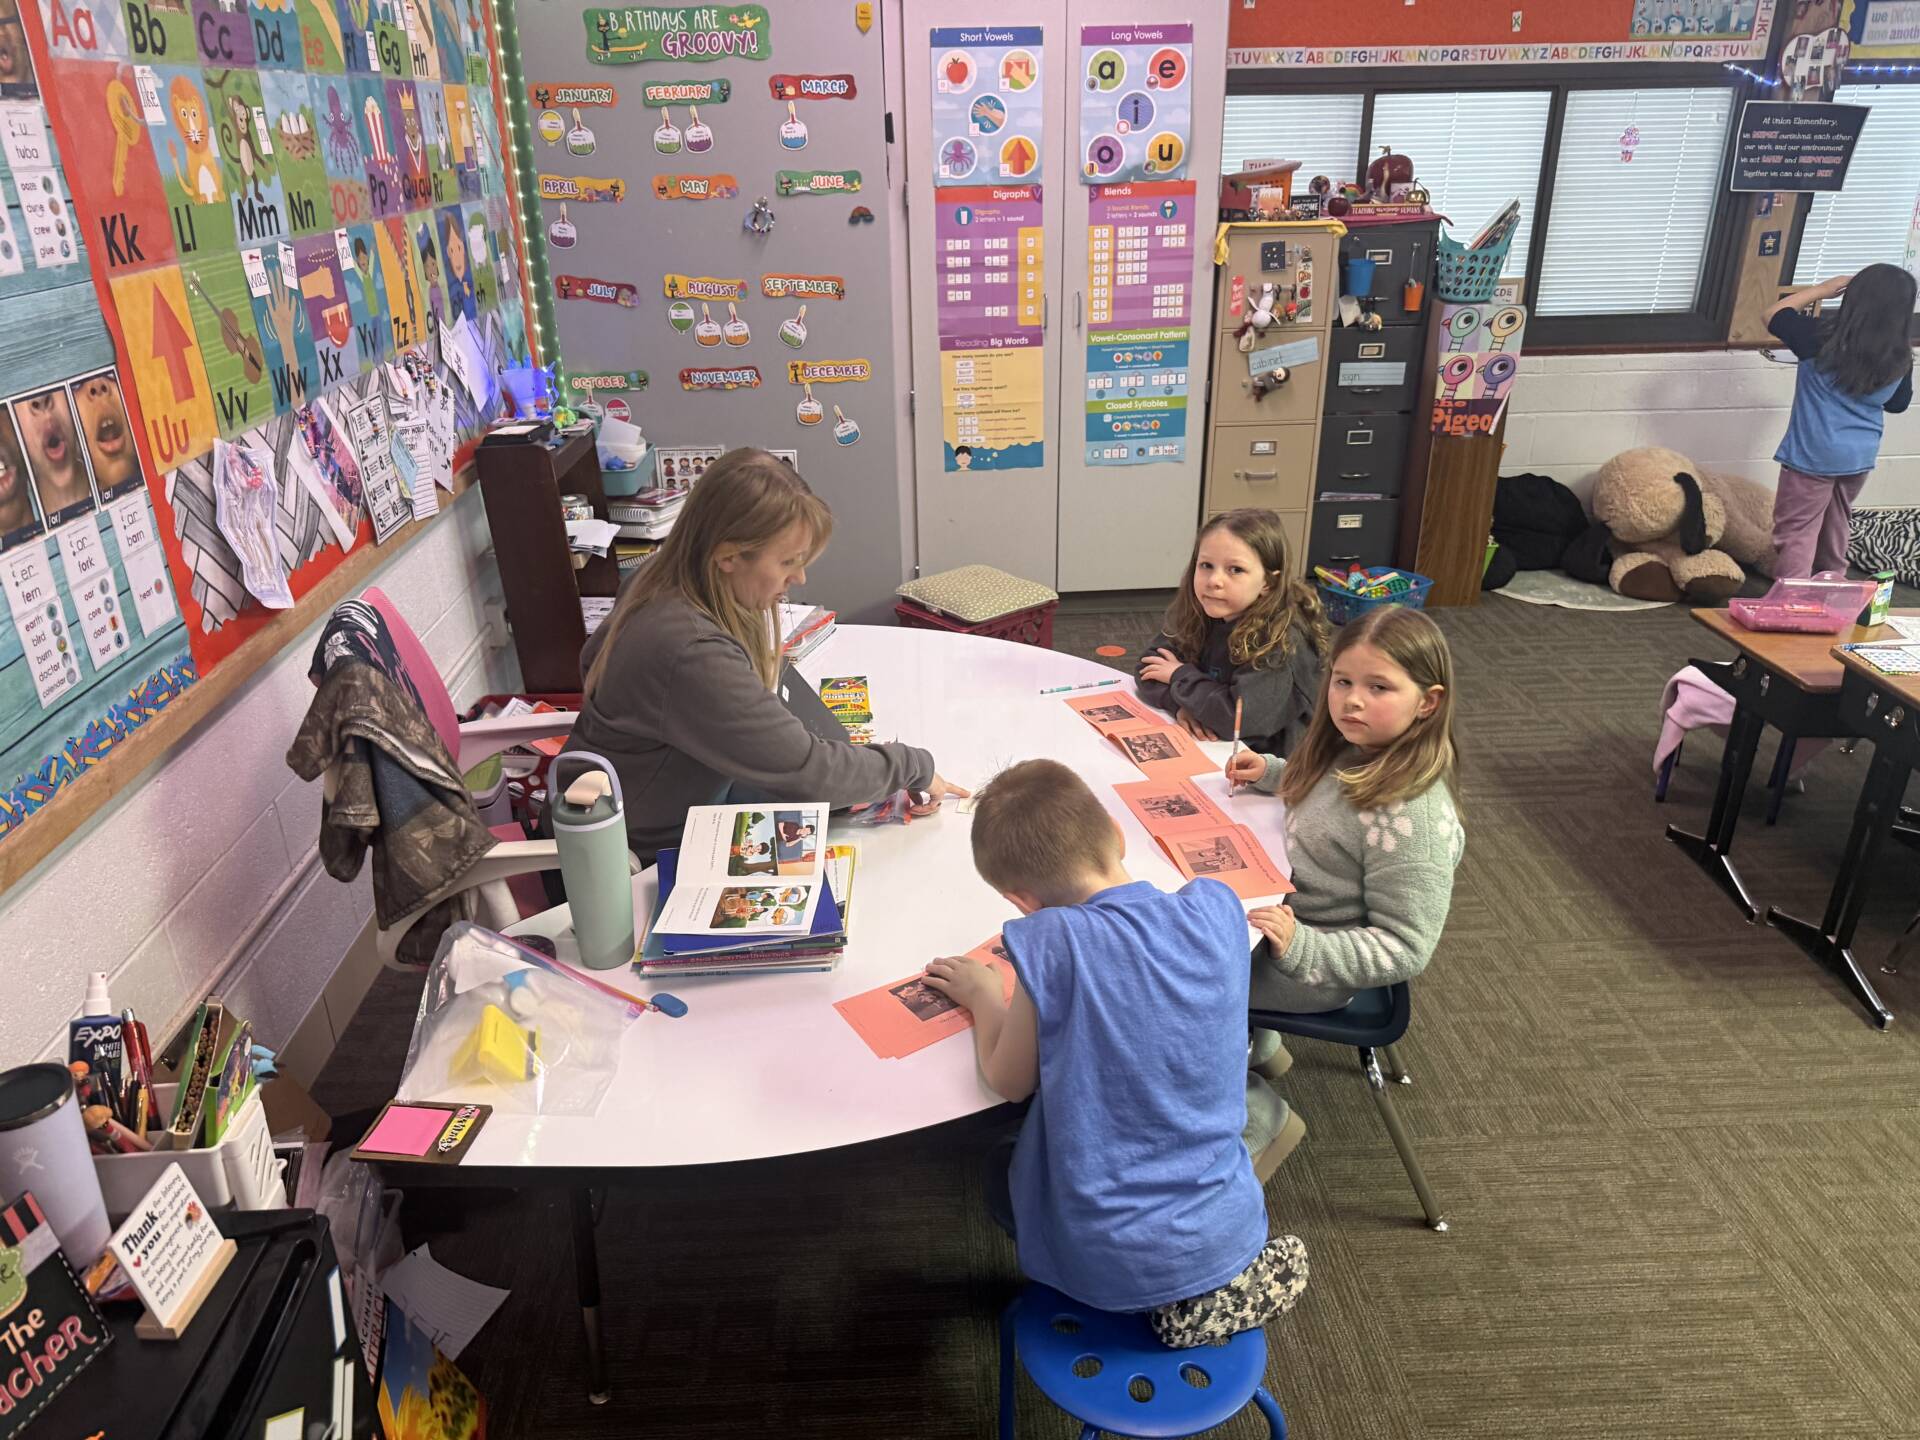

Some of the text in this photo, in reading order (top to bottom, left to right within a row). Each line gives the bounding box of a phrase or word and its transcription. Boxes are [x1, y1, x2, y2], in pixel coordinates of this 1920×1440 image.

[49, 0, 97, 50] Aa
[127, 2, 167, 56] Bb
[609, 9, 719, 33] BRTHDAYS ARE
[199, 11, 234, 60] Cc
[254, 19, 286, 63] Dd
[960, 32, 1014, 41] Short Vowels
[1111, 31, 1163, 42] Long Vowels
[1889, 24, 1920, 41] anoth
[303, 25, 325, 66] Ee
[379, 30, 402, 75] Gg
[661, 30, 758, 58] GROOVY!
[411, 43, 429, 77] Hh
[1158, 59, 1176, 79] e
[1098, 60, 1116, 80] a
[554, 88, 613, 103] JANUARY
[646, 86, 711, 100] FEBRUARY
[801, 80, 848, 96] MARCH
[1133, 99, 1139, 125] i
[15, 145, 39, 159] tuba
[1097, 145, 1114, 164] o
[1158, 143, 1172, 162] u
[433, 172, 444, 203] Rr
[543, 179, 579, 195] APRIL
[680, 180, 709, 194] MAY
[810, 175, 844, 190] JUNE
[1104, 186, 1132, 195] Blends
[331, 182, 359, 223] Oo
[369, 173, 388, 214] Pp
[993, 190, 1030, 200] Digraphs
[236, 197, 281, 242] Mm
[287, 190, 317, 231] Nn
[174, 203, 198, 253] Ll
[101, 213, 146, 268] Kk
[588, 284, 617, 299] JULY
[687, 281, 738, 297] AUGUST
[765, 279, 840, 294] SEPTEMBER
[990, 337, 1003, 347] Big
[1005, 336, 1030, 345] Words
[319, 349, 345, 388] Xx
[1251, 352, 1284, 370] cabinet
[690, 371, 757, 384] NOVEMBER
[802, 364, 868, 378] DECEMBER
[272, 361, 309, 407] Ww
[571, 376, 628, 390] OCTOBER
[217, 386, 248, 430] Vv
[1106, 399, 1168, 410] Closed Syllables
[1432, 407, 1493, 436] Pigeo
[151, 413, 190, 464] Uu
[126, 528, 146, 547] barn
[79, 556, 95, 574] fork
[22, 586, 42, 606] fern
[25, 614, 44, 633] earth
[32, 633, 47, 648] bird
[37, 649, 53, 665] burn
[39, 662, 61, 683] doctor
[73, 1024, 121, 1047] EXPO
[93, 1049, 121, 1060] BARD
[121, 1210, 159, 1256] Thank
[140, 1230, 162, 1260] you
